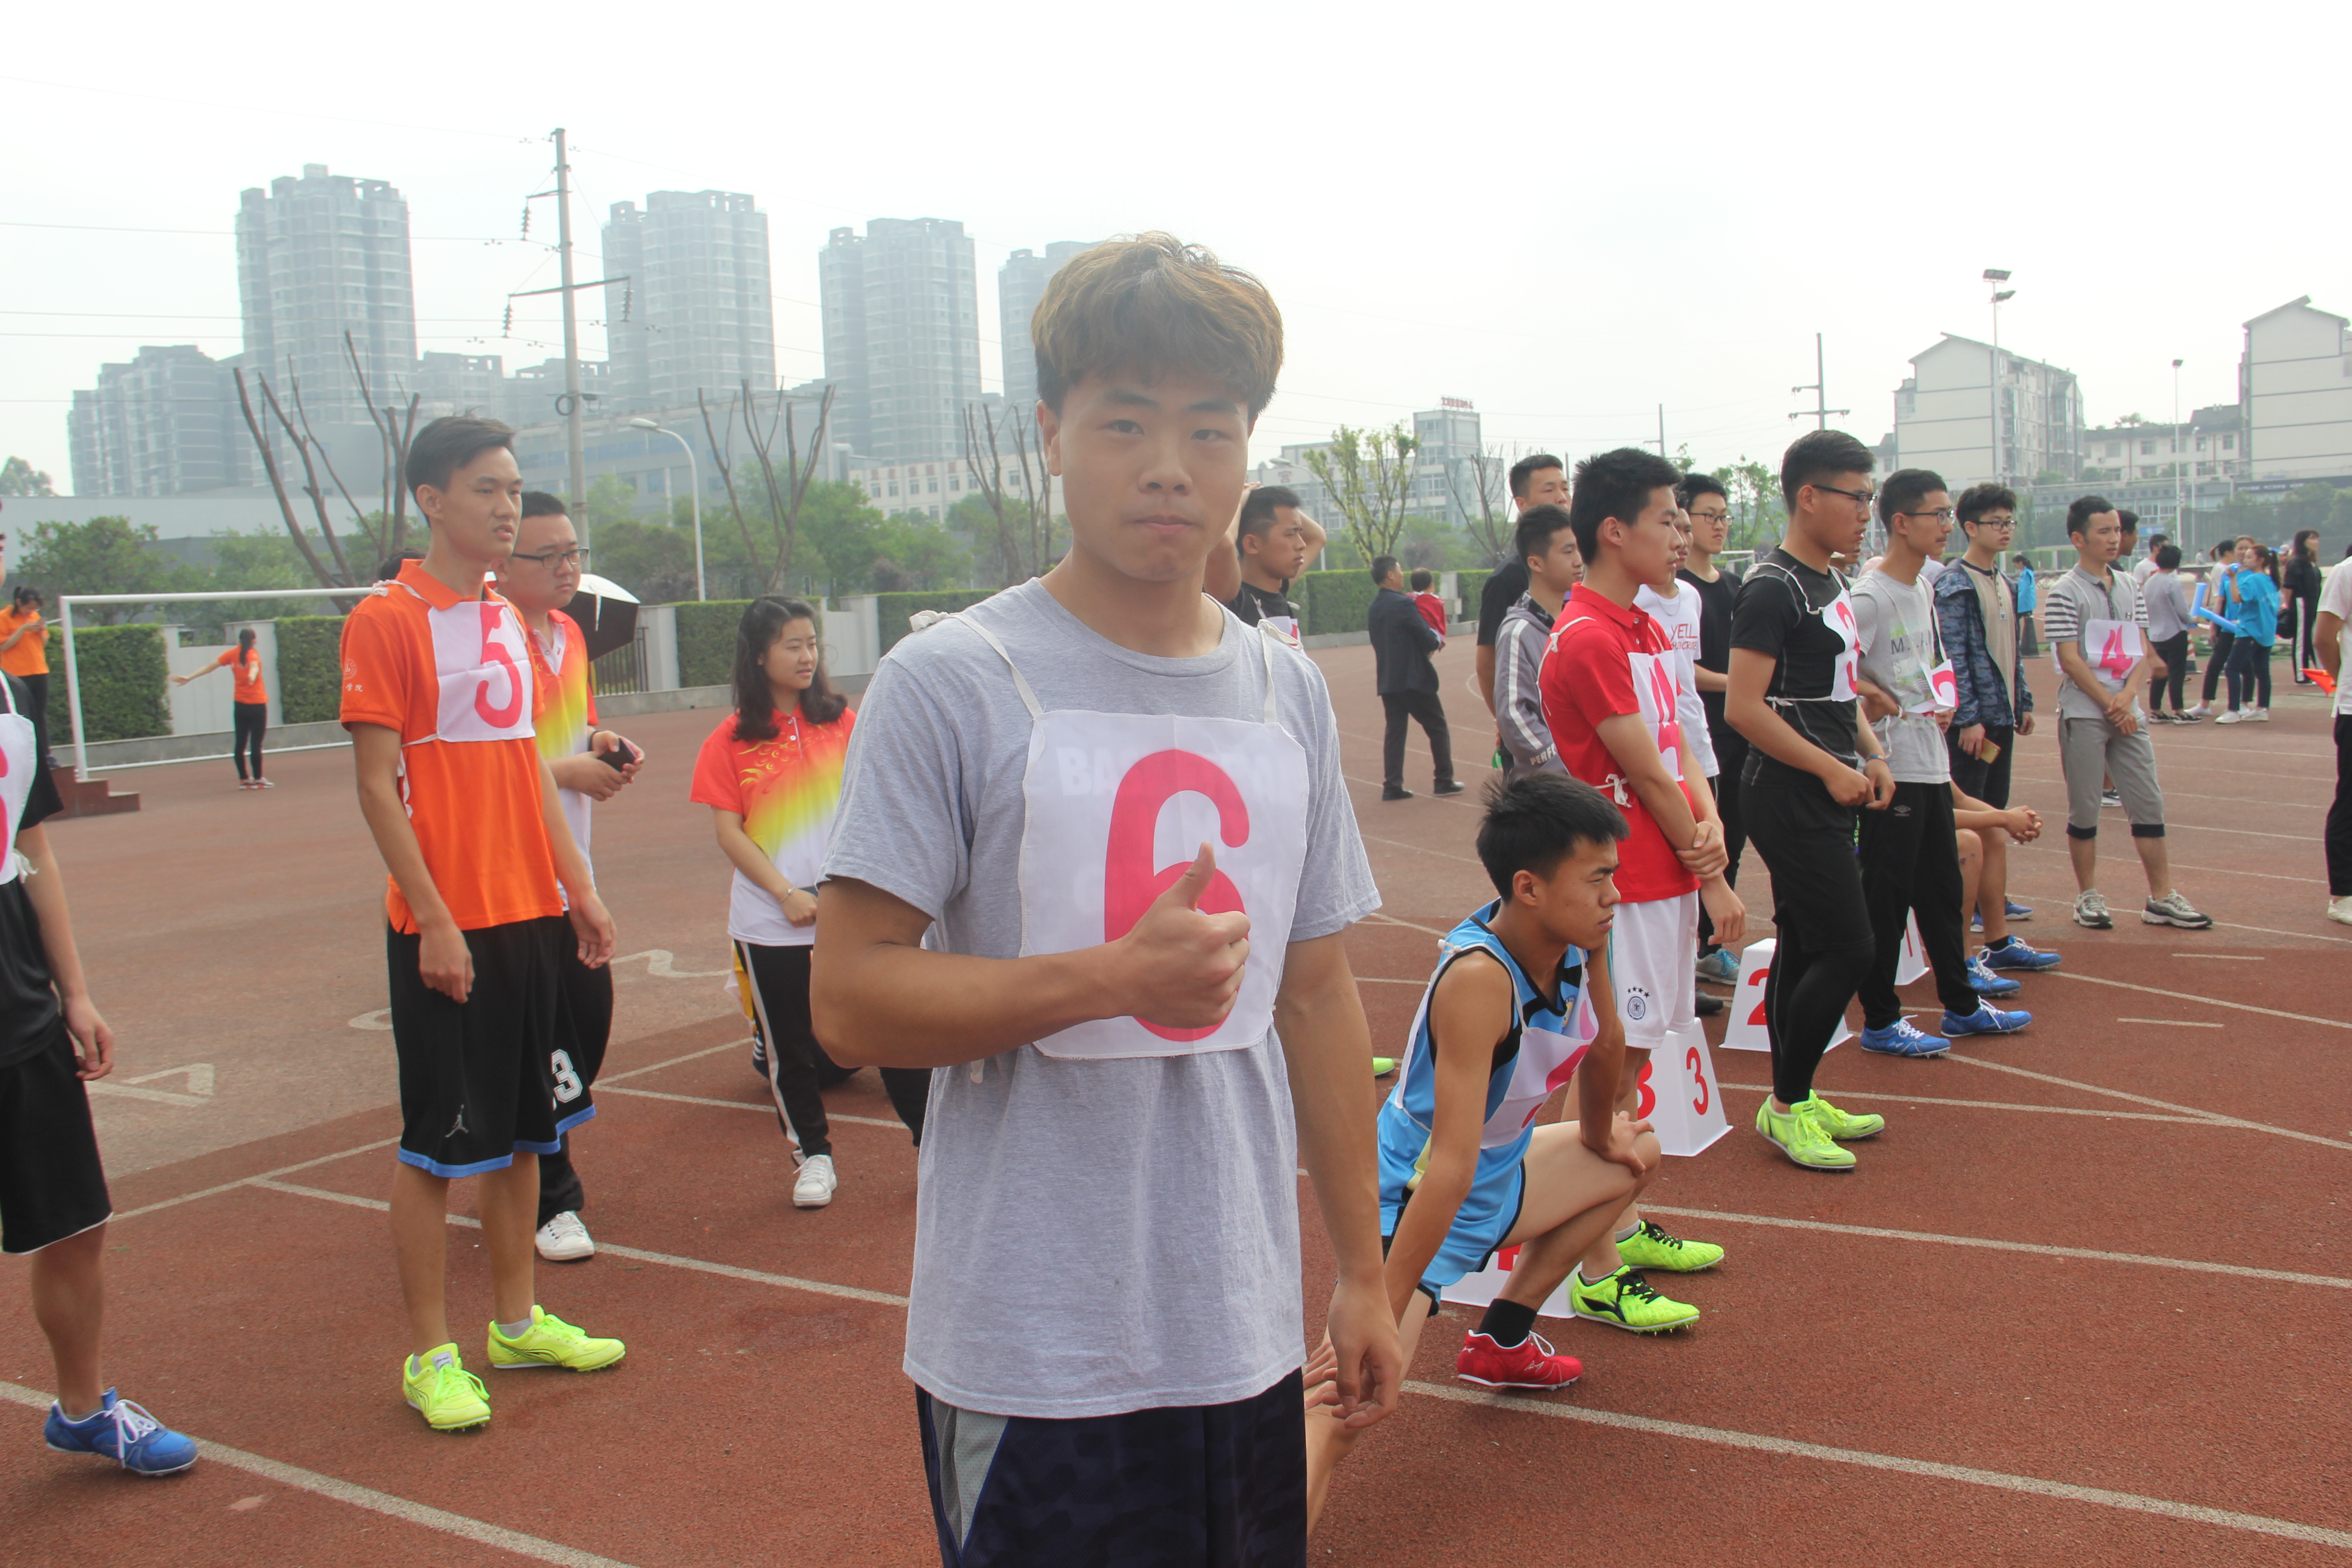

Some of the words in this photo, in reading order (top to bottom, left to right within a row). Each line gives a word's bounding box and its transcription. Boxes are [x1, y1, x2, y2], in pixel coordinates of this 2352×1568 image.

[475, 603, 523, 729] 5
[2099, 624, 2133, 679] 4
[1104, 749, 1250, 1042] 6
[552, 1049, 583, 1103] 3
[1686, 1047, 1709, 1115] 3
